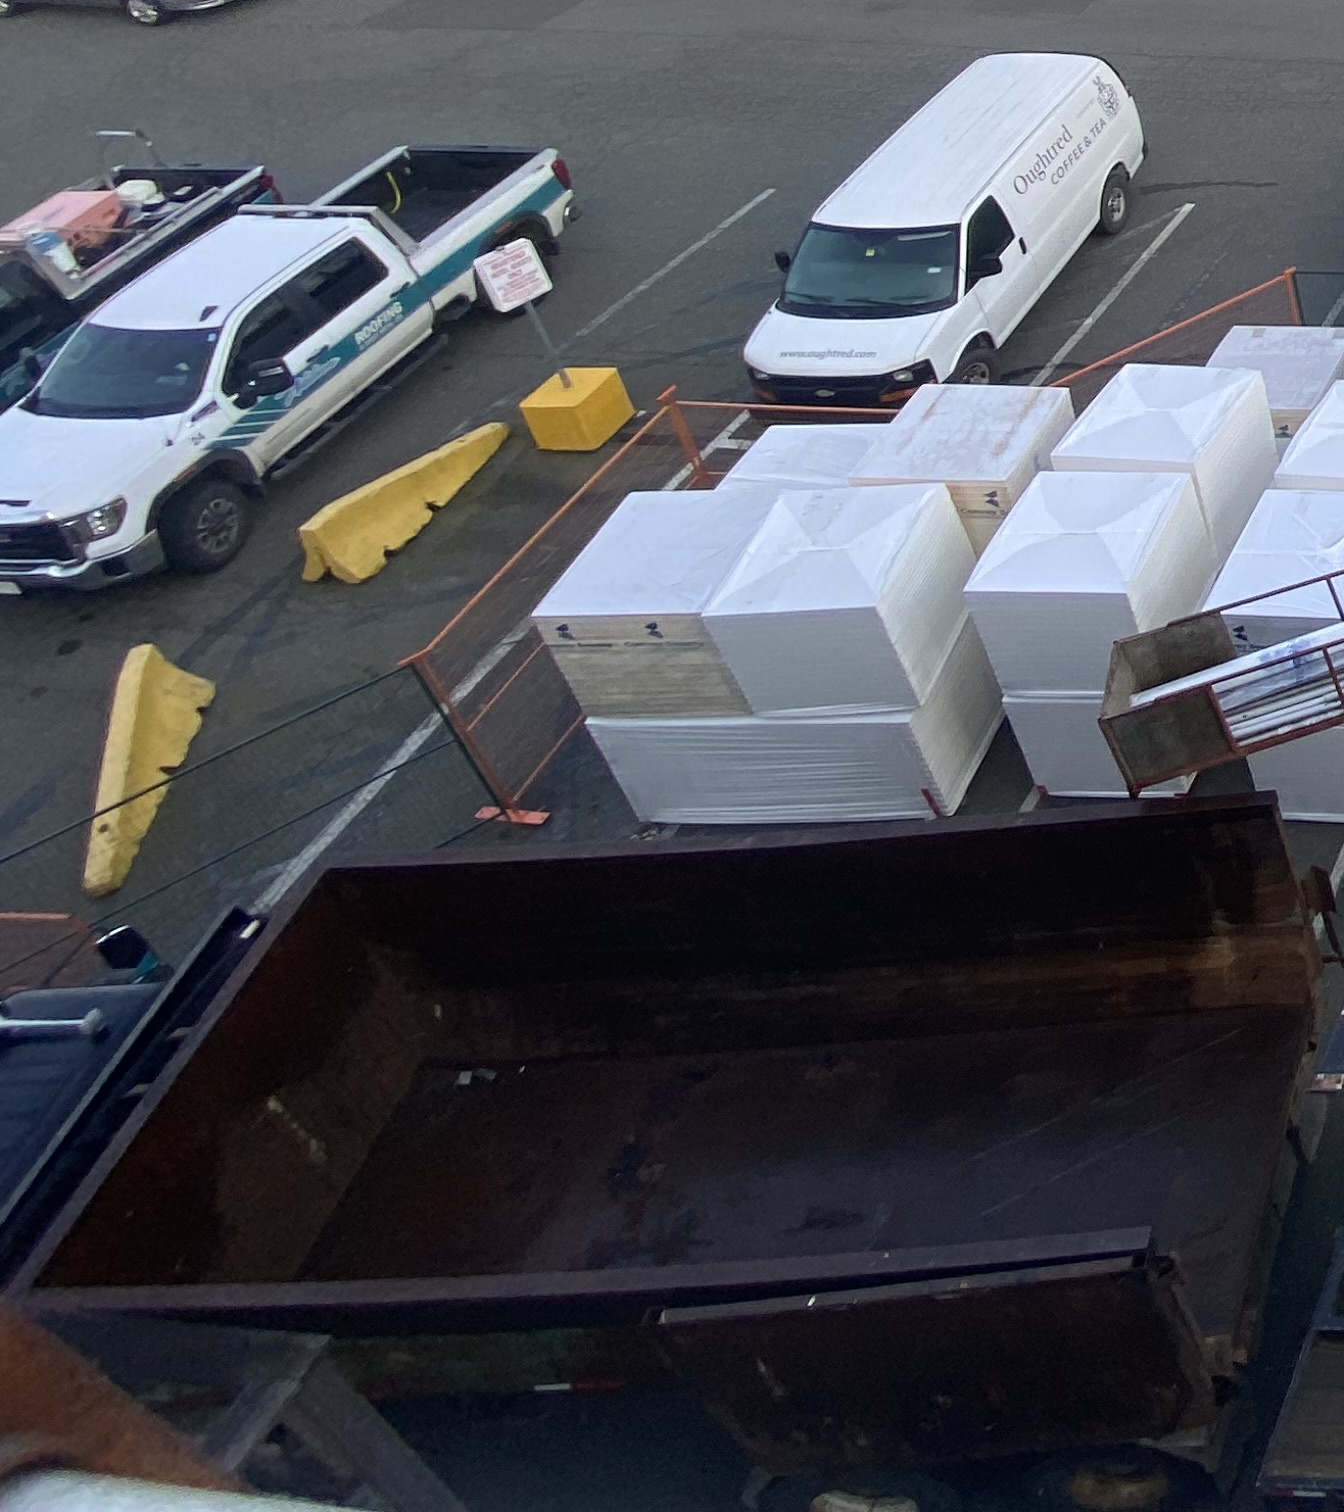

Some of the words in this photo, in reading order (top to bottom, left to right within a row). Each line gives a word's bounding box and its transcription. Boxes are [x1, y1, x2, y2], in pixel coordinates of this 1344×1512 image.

[1013, 123, 1073, 195] Oughtred
[1051, 143, 1085, 185] COFFEE
[1083, 135, 1092, 148] &
[1090, 117, 1107, 139] TEA
[354, 301, 403, 345] ROOFING
[779, 349, 877, 360] www.oughtred.com
